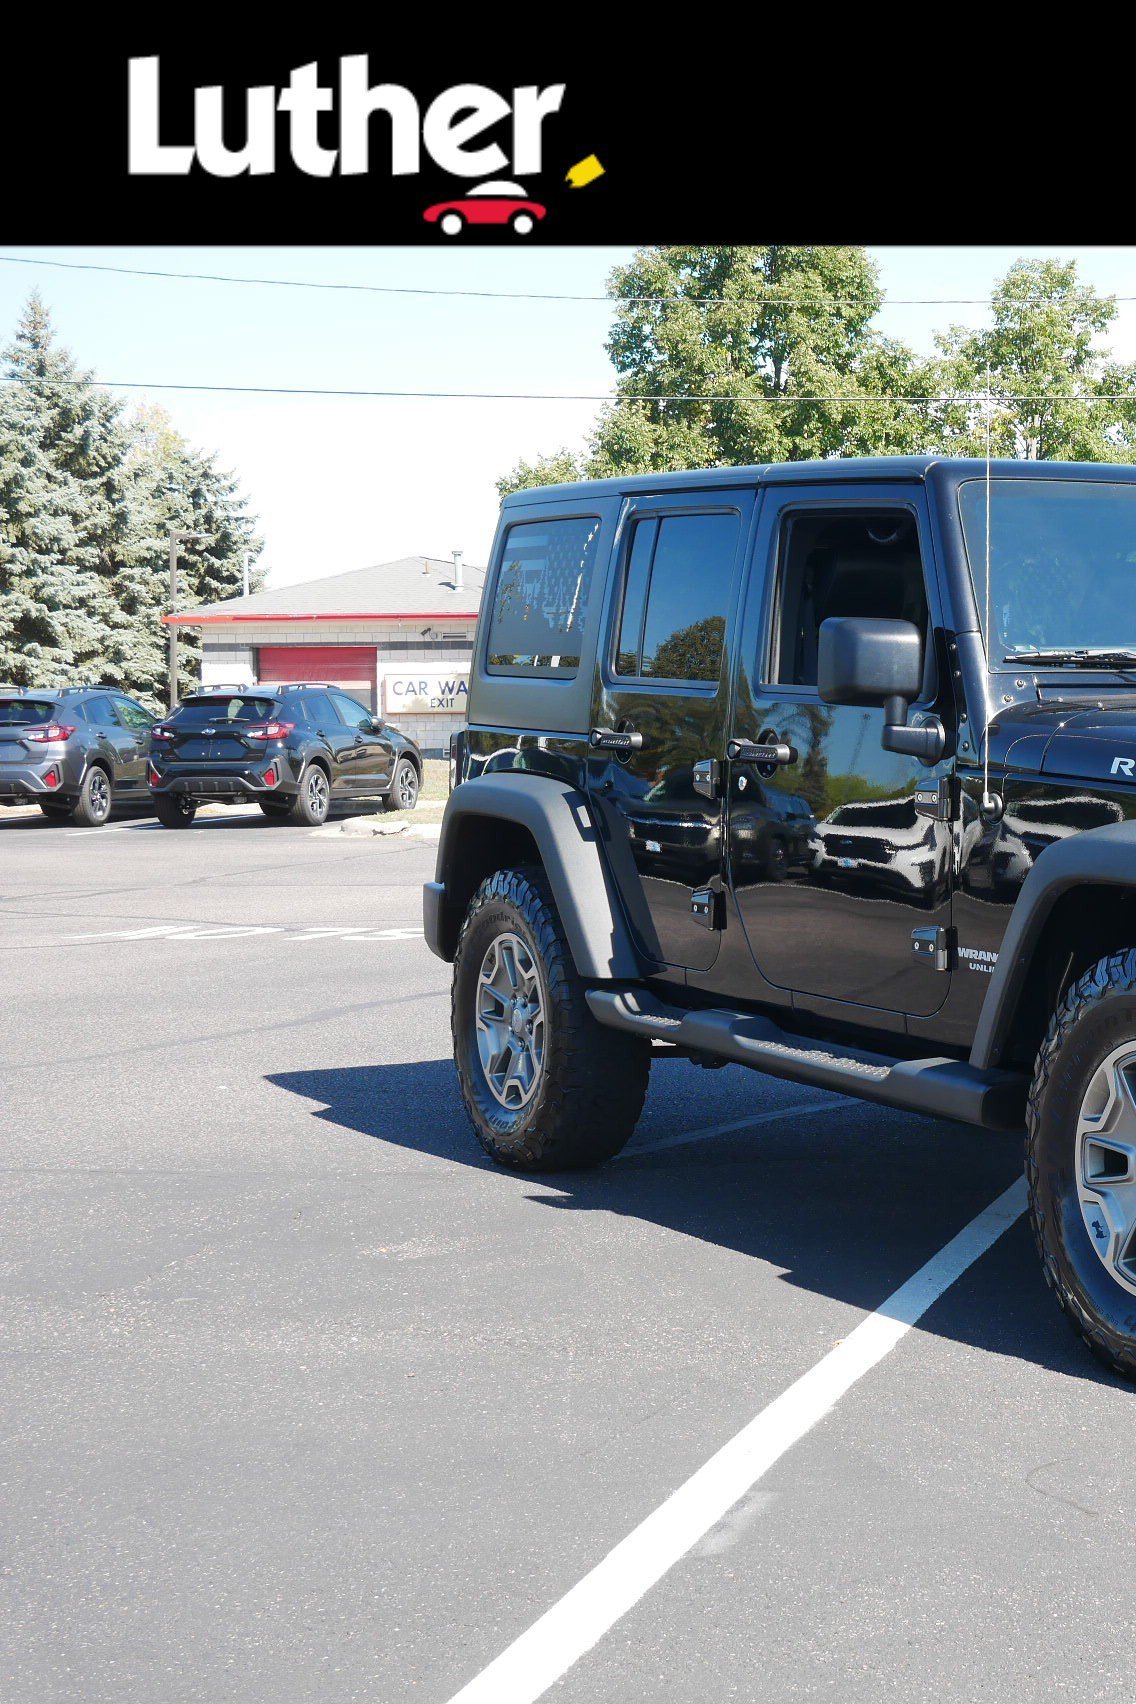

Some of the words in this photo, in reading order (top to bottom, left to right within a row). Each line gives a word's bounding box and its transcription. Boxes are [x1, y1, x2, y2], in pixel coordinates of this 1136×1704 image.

[392, 681, 429, 696] CAR
[438, 681, 468, 696] WA
[430, 698, 455, 708] EXIT
[957, 946, 999, 963] WRAN
[969, 962, 996, 973] UNLI
